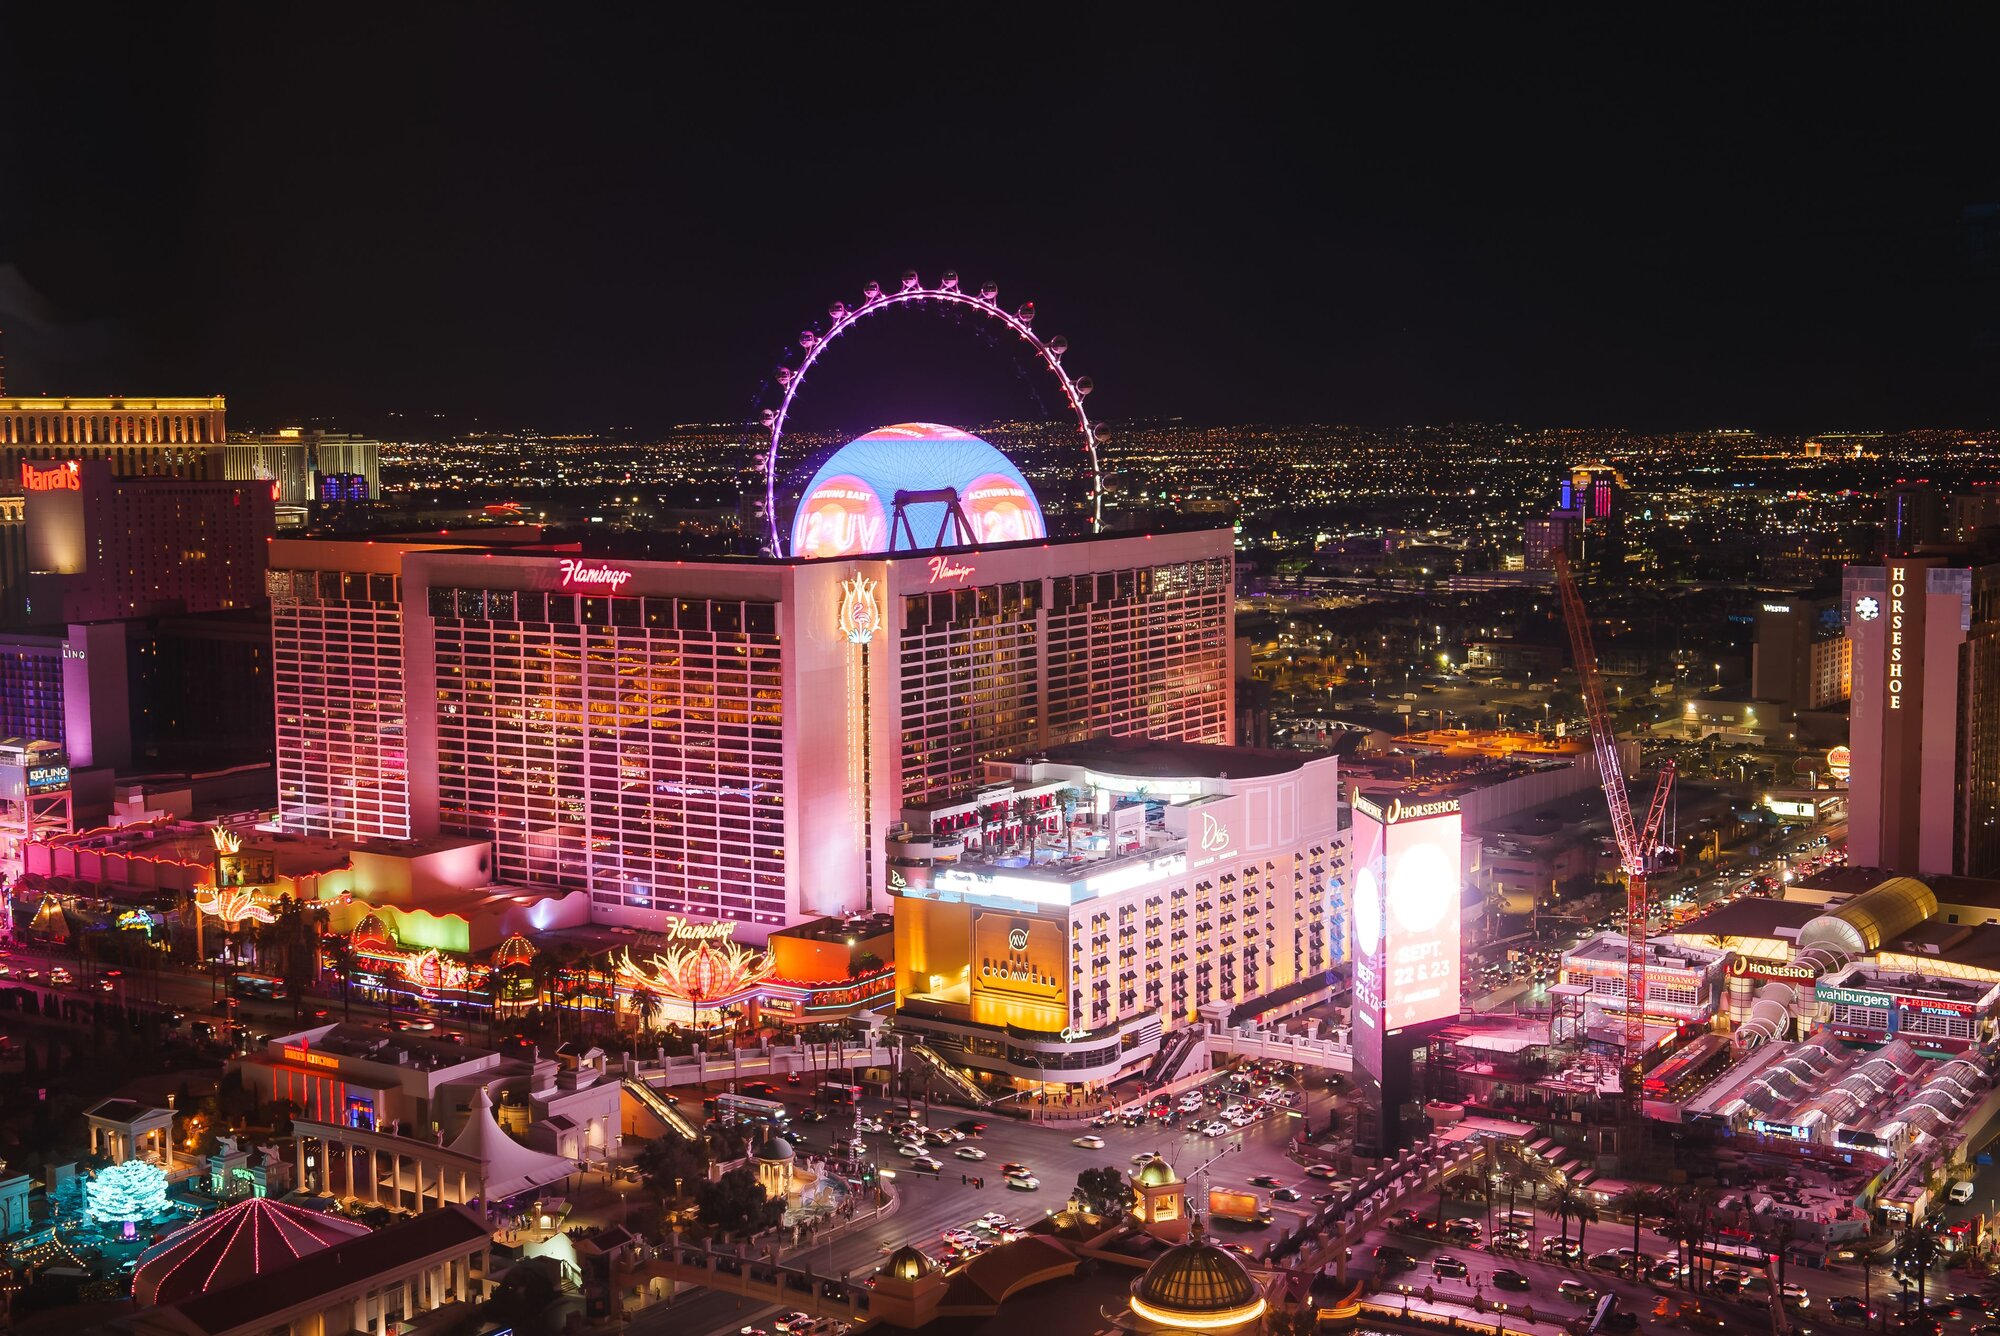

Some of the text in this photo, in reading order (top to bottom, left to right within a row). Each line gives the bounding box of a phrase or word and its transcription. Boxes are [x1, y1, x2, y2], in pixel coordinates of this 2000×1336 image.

[846, 490, 872, 501] BABY
[968, 488, 1008, 500] ACHTUNG
[560, 559, 632, 592] Flamingo
[928, 556, 975, 583] Flamingo
[1889, 567, 1905, 709] HORSESHOE
[63, 650, 85, 659] LINQ
[1400, 800, 1460, 819] HORSESHOE
[666, 916, 737, 942] Flamingo
[1398, 941, 1442, 963] SEPT.
[1009, 959, 1029, 970] THE
[1394, 967, 1414, 986] 22
[1417, 964, 1428, 980] &
[1431, 960, 1450, 978] 23
[1749, 963, 1815, 979] HORSESHOE
[982, 966, 1056, 988] CROMWELL
[1817, 989, 1890, 1007] wahlburgers
[1911, 999, 1973, 1013] REDNECK
[1921, 1007, 1961, 1017] RIVIERA
